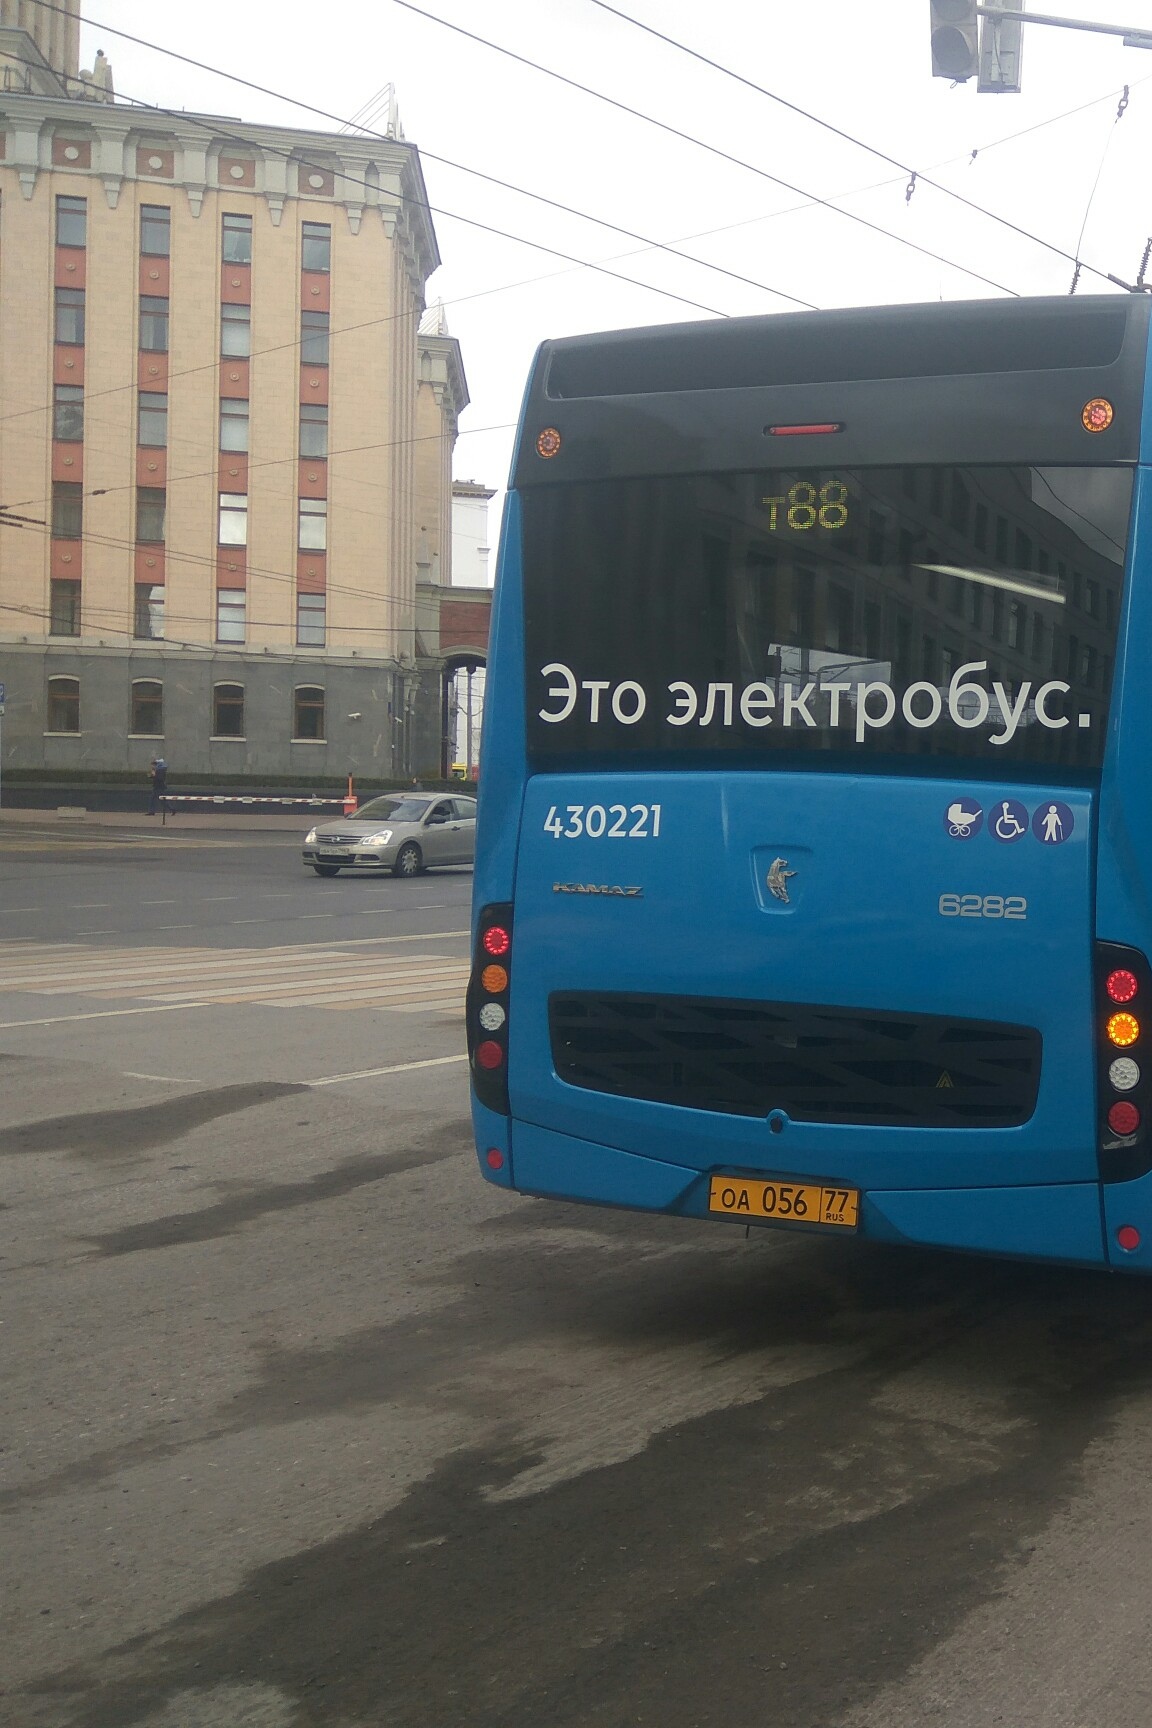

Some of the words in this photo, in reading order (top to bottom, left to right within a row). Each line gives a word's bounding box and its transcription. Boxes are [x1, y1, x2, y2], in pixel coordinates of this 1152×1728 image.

[537, 662, 646, 726] Это
[665, 660, 1092, 746] электробус.
[542, 804, 662, 839] 430221
[552, 881, 644, 898] KAMAZ
[938, 893, 1027, 920] 6282
[762, 1186, 808, 1216] 056
[825, 1190, 849, 1213] 77
[825, 1212, 845, 1222] RUS
